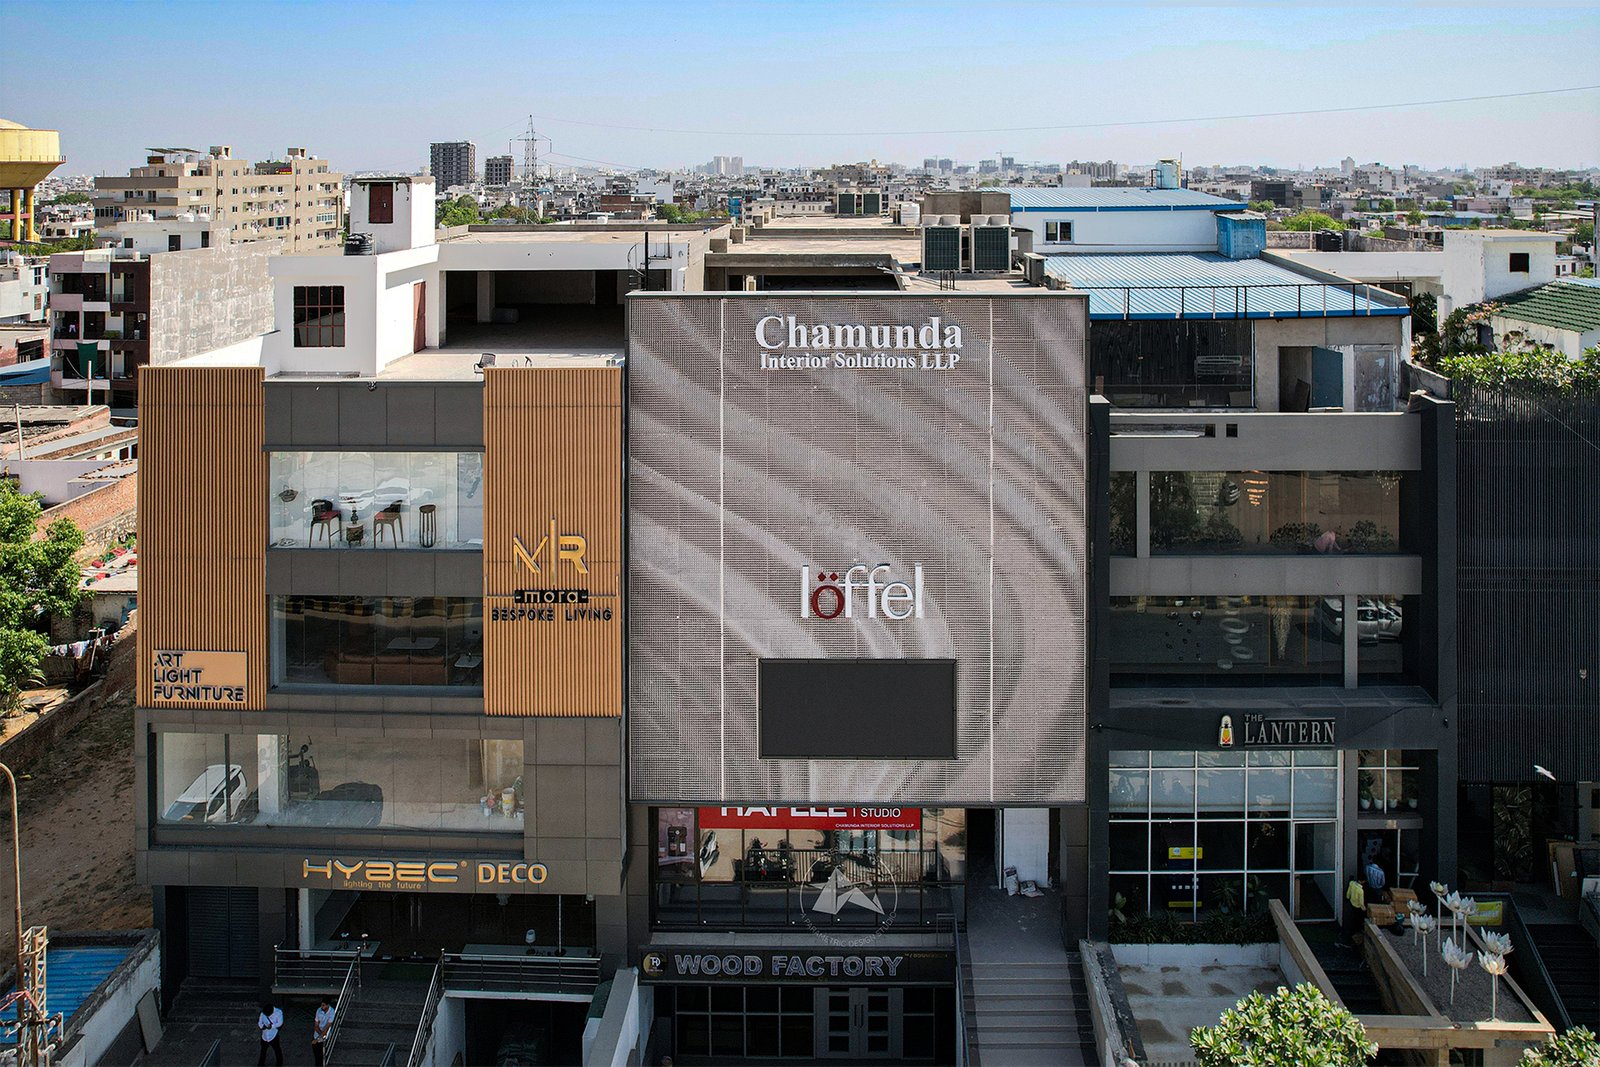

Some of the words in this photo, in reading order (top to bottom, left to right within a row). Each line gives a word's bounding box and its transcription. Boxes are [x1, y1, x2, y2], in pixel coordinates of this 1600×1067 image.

[755, 314, 963, 350] Chamunda
[760, 353, 829, 370] Interior
[834, 352, 916, 369] Solutions
[921, 353, 960, 370] LLP
[800, 562, 923, 620] löffel
[492, 607, 555, 622] BESPOKE
[565, 607, 612, 622] LIVING
[153, 653, 184, 668] ART
[153, 669, 203, 684] LIGHT
[153, 685, 244, 702] FURNITURE
[1244, 714, 1264, 722] THE
[1244, 721, 1336, 744] LANTERN
[860, 807, 901, 818] STUDIO
[478, 862, 548, 884] DECO
[343, 880, 373, 890] lighting
[378, 881, 392, 889] the
[396, 881, 422, 890] future
[674, 954, 763, 976] WOOD
[771, 955, 904, 977] FACTORY
